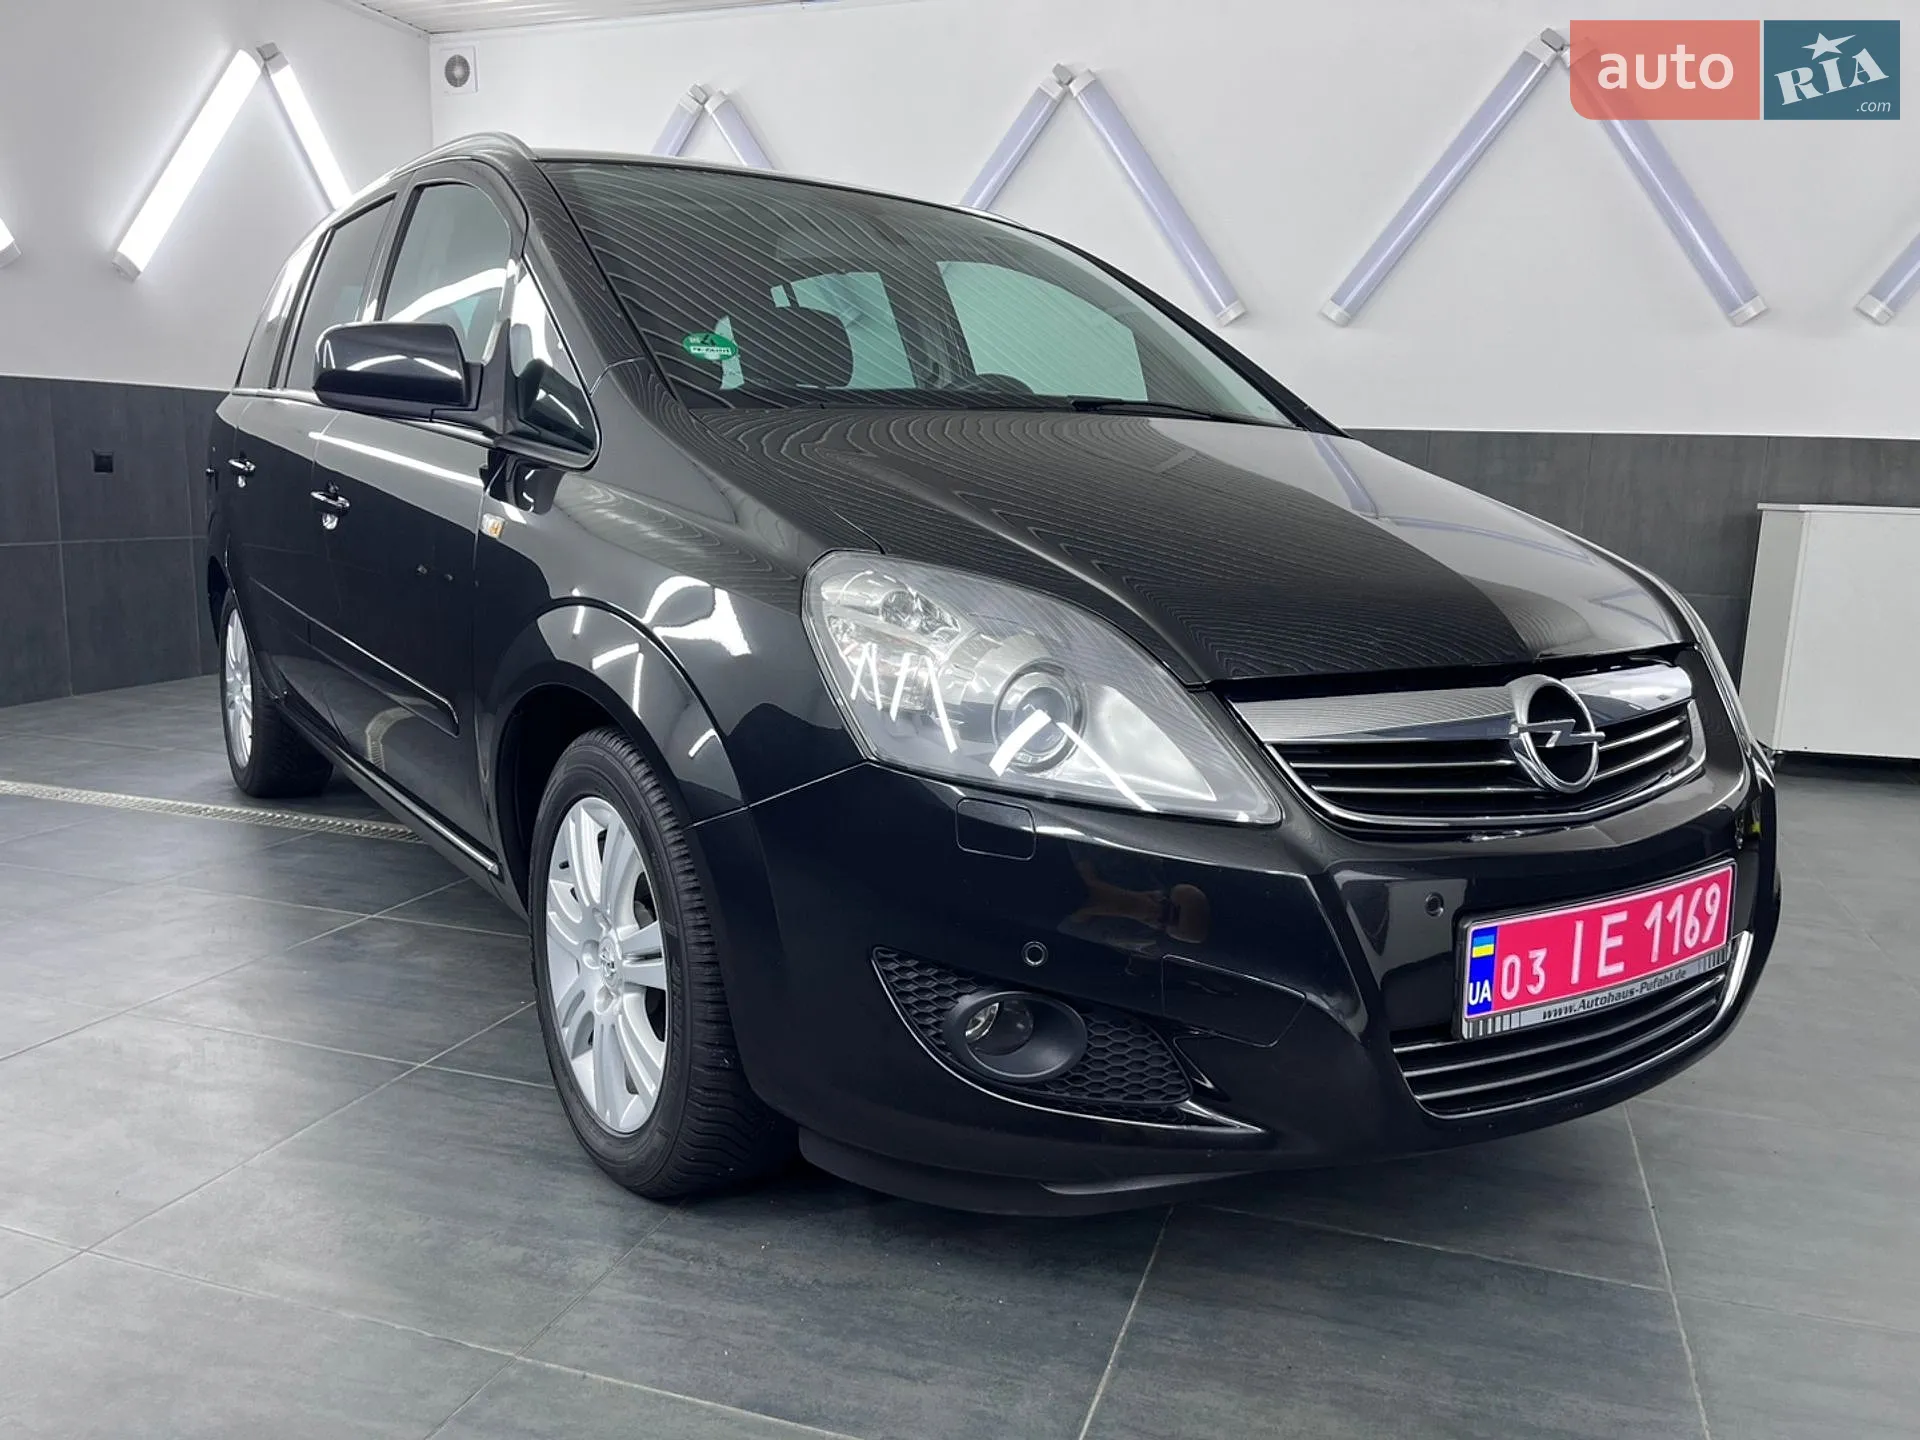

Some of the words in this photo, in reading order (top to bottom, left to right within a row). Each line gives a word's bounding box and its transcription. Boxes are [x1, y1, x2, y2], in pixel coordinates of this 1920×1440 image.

[1501, 948, 1547, 1000] 03
[1571, 911, 1628, 985] IE
[1644, 882, 1721, 963] 1169
[1468, 980, 1491, 1006] UA
